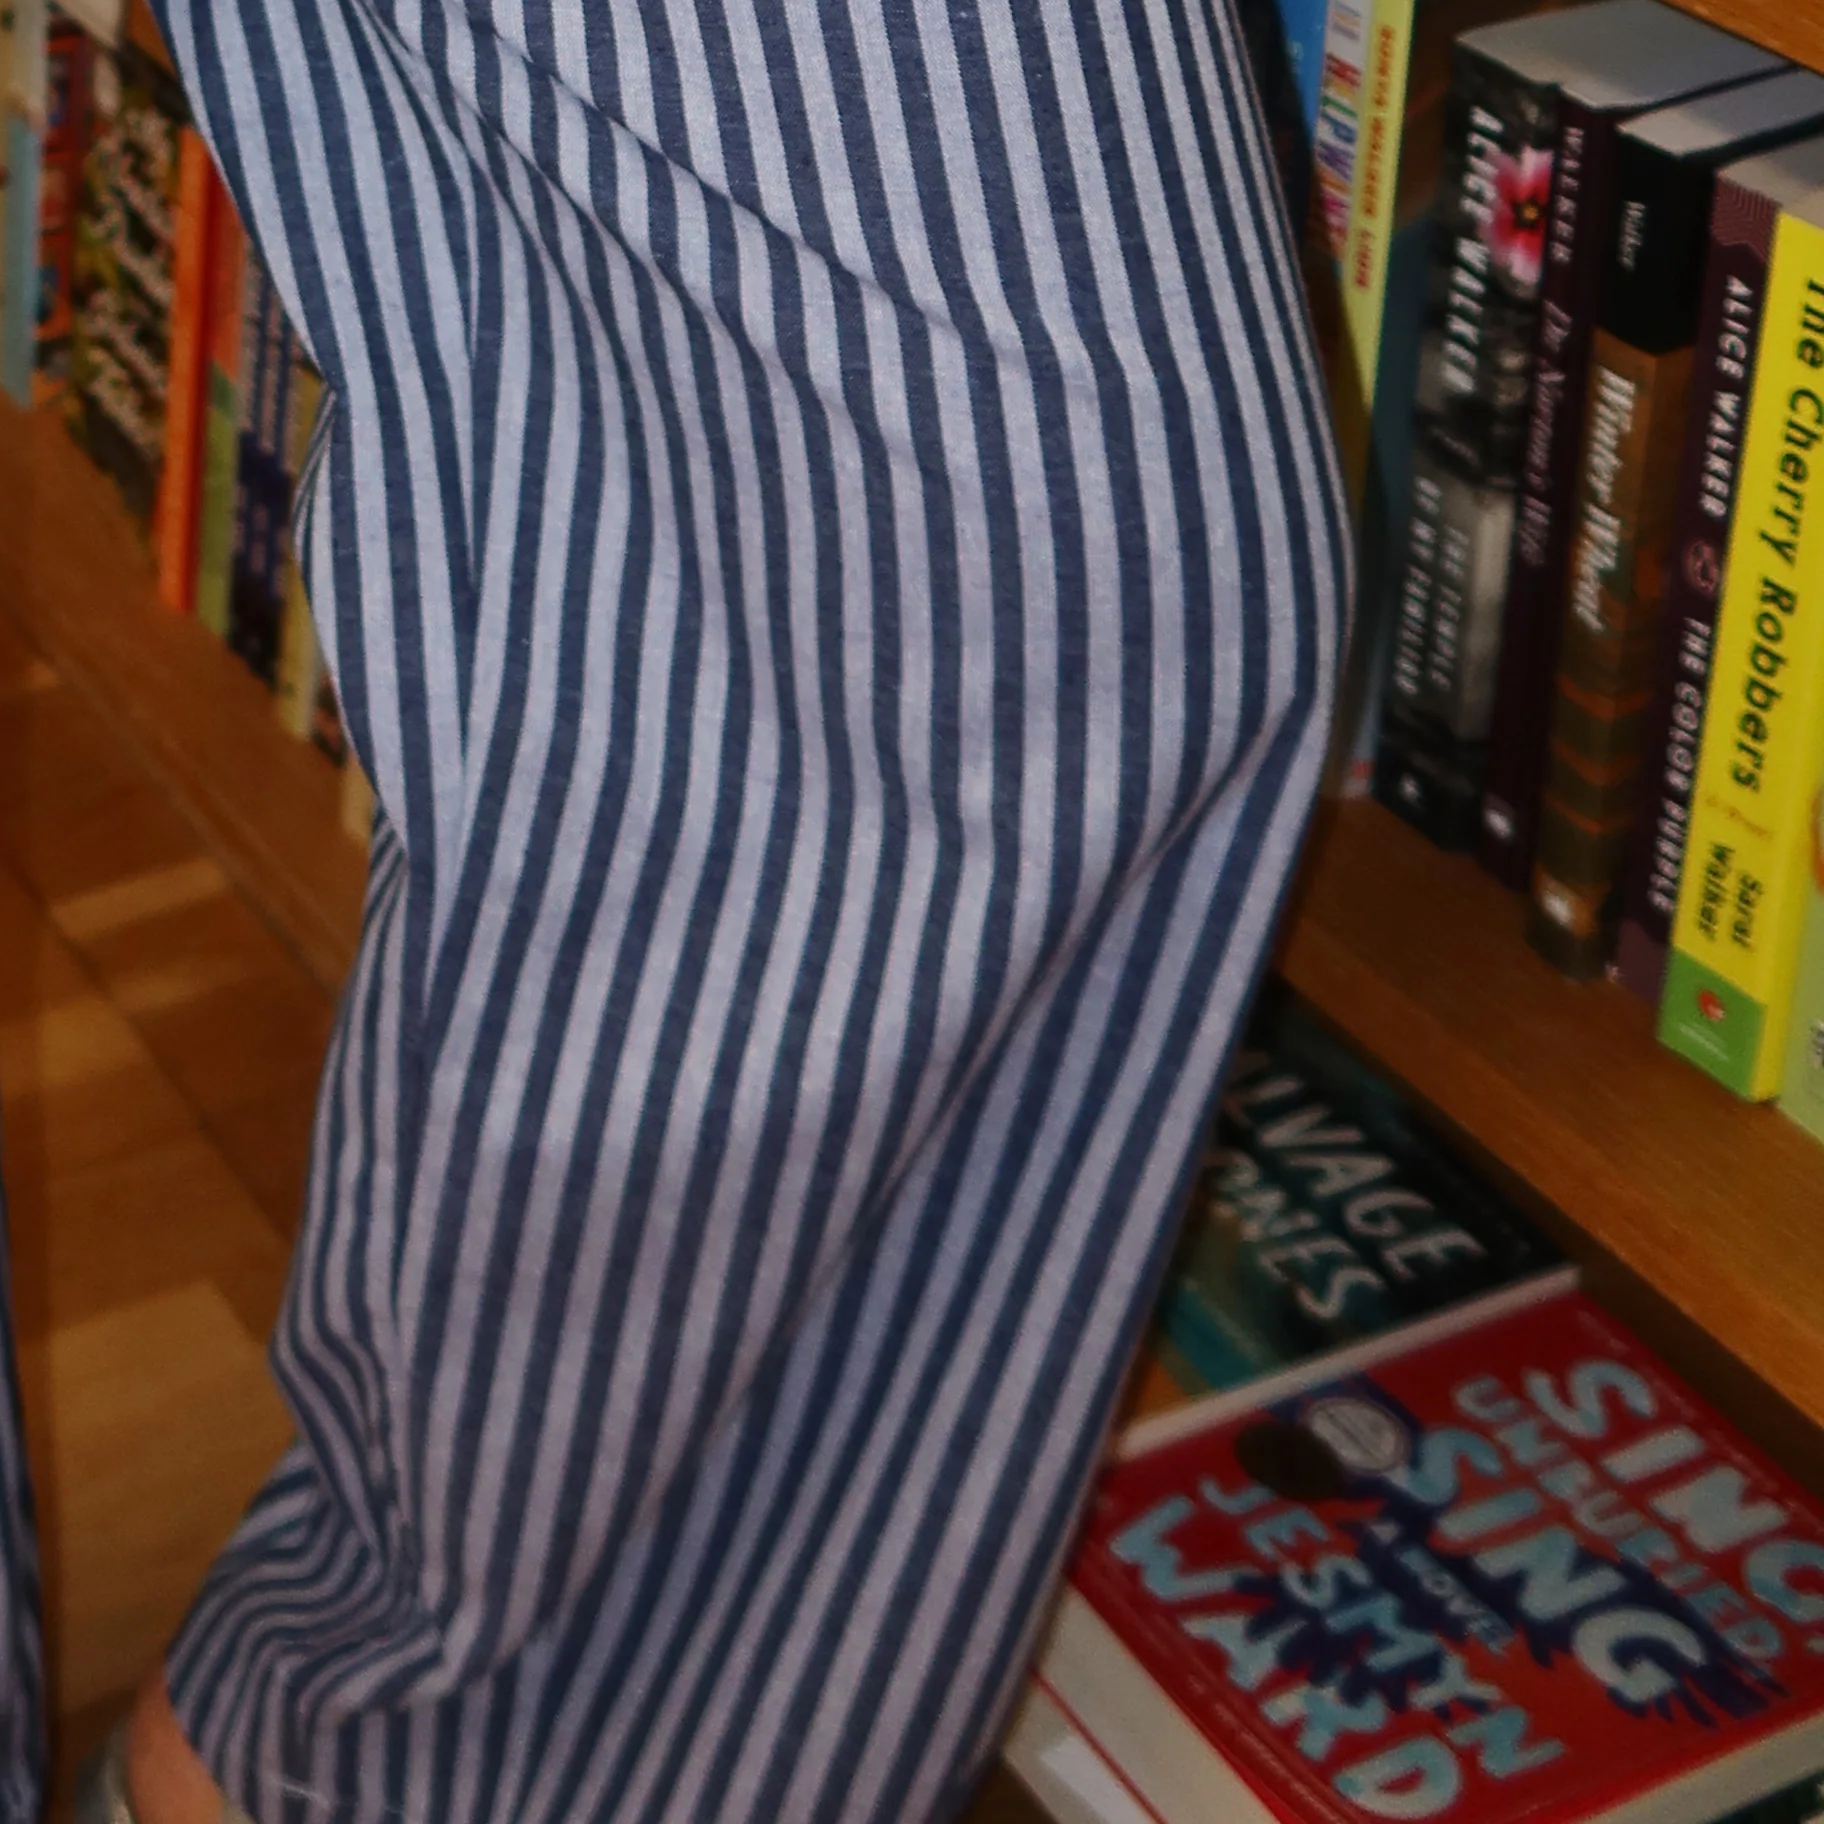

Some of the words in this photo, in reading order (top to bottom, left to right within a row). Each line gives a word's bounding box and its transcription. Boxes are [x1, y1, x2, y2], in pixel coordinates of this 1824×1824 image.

[1715, 274, 1755, 380] ALICE
[1699, 390, 1742, 519] WALKER
[1758, 386, 1824, 567] Cherry
[1729, 575, 1799, 794] Robbers
[1224, 1072, 1489, 1280] LVAGE
[1107, 1492, 1462, 1821] WARD
[1196, 1474, 1567, 1781] JESMYN
[1383, 1425, 1709, 1704] SING
